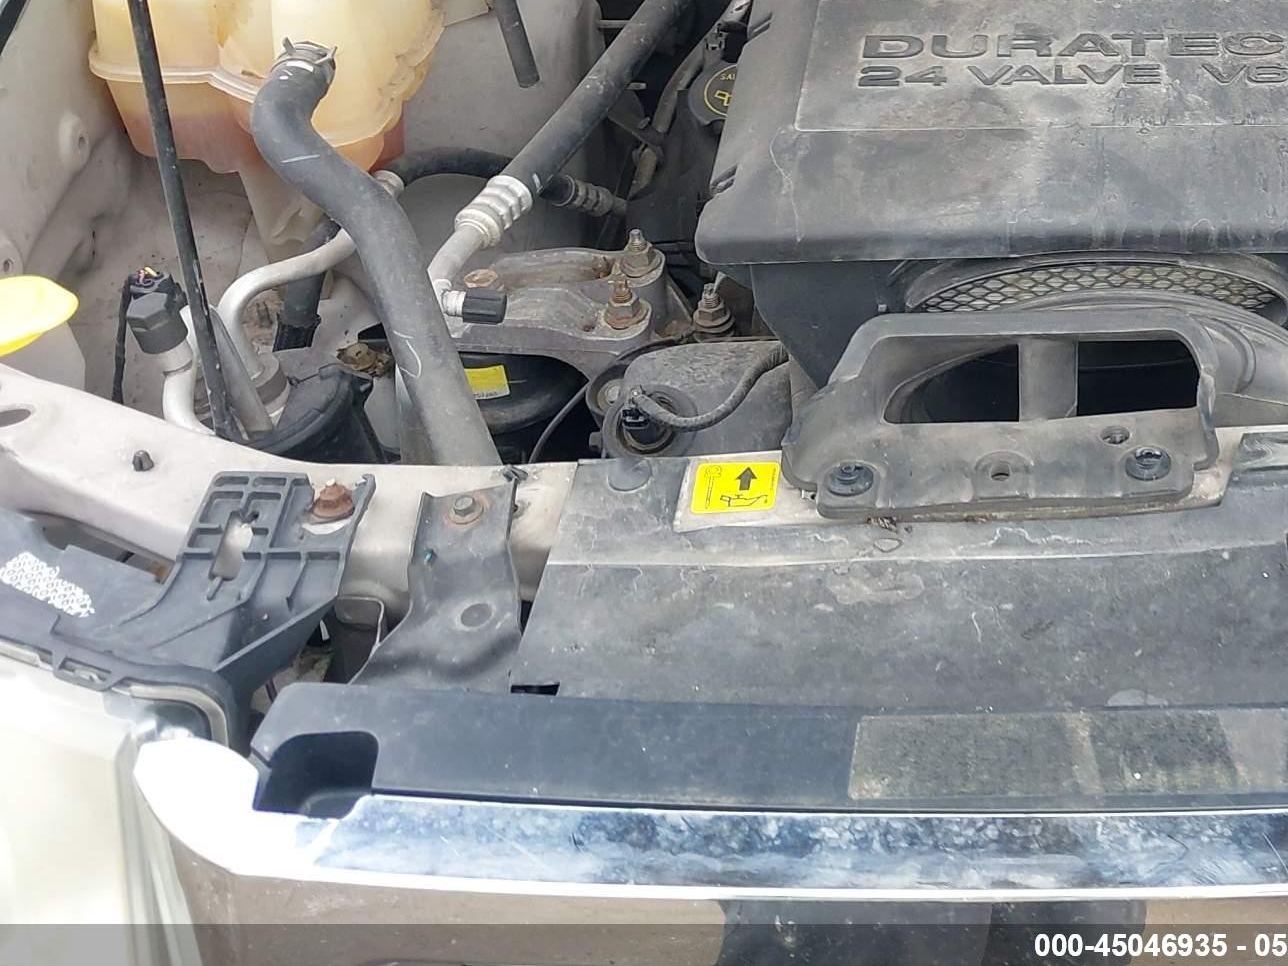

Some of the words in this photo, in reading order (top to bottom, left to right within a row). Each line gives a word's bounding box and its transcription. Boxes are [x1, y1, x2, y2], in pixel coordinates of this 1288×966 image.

[862, 32, 1287, 60] DURATEC
[857, 64, 948, 88] 24
[967, 63, 1162, 87] VALVE
